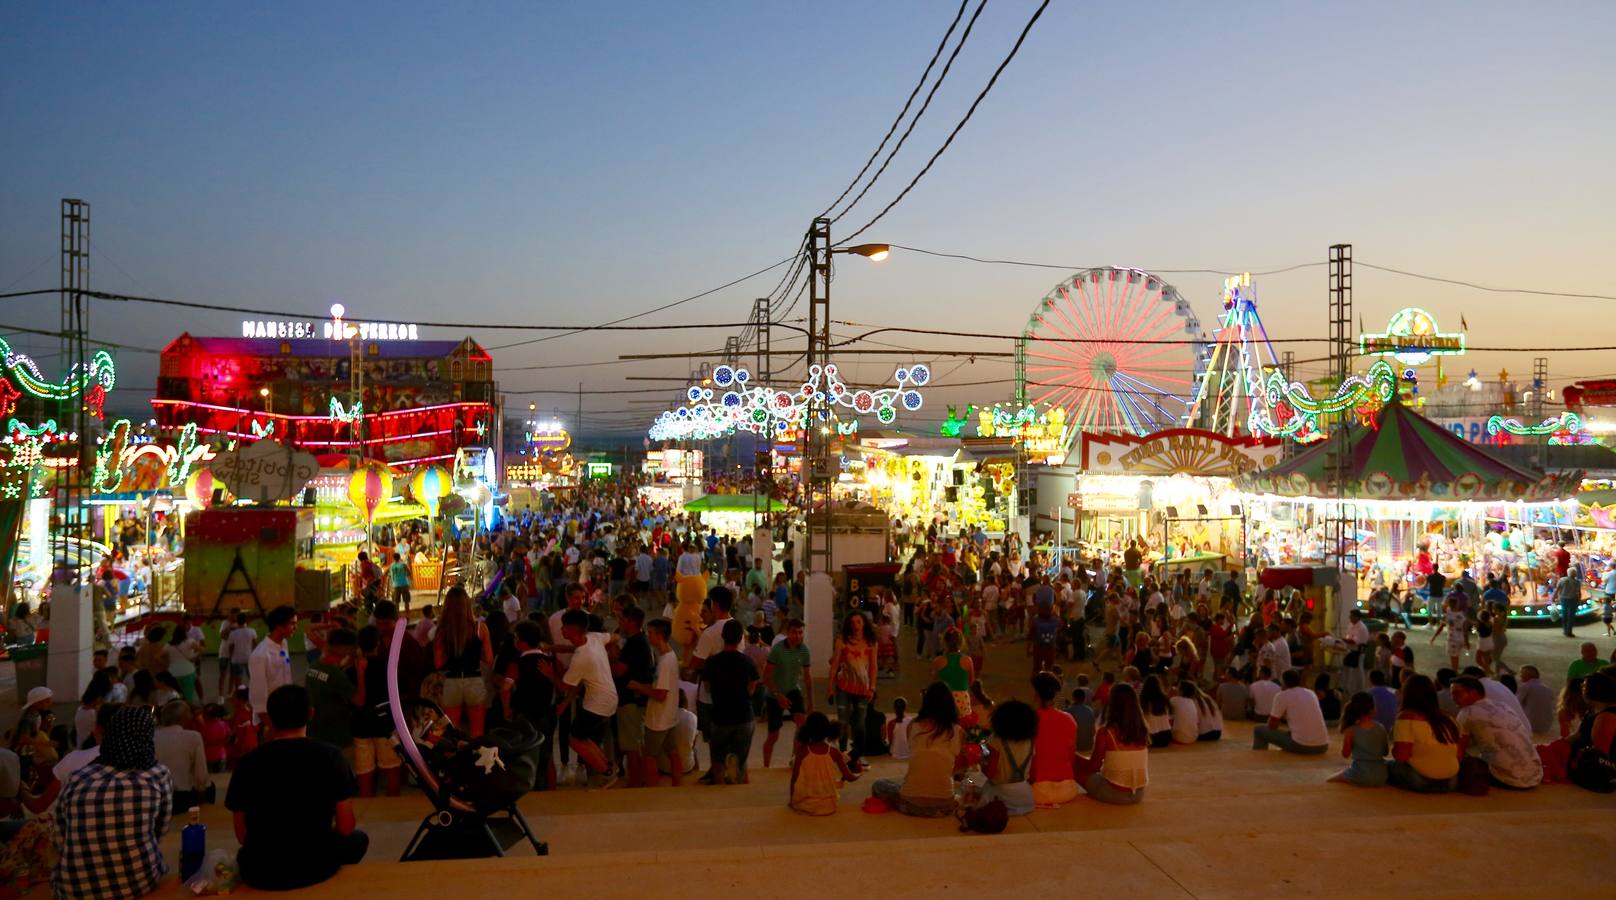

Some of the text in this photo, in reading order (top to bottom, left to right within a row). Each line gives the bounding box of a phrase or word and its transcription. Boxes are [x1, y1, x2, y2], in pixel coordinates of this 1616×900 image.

[359, 323, 418, 340] TERROR
[1118, 440, 1165, 471] EURO
[1168, 434, 1216, 454] BALL
